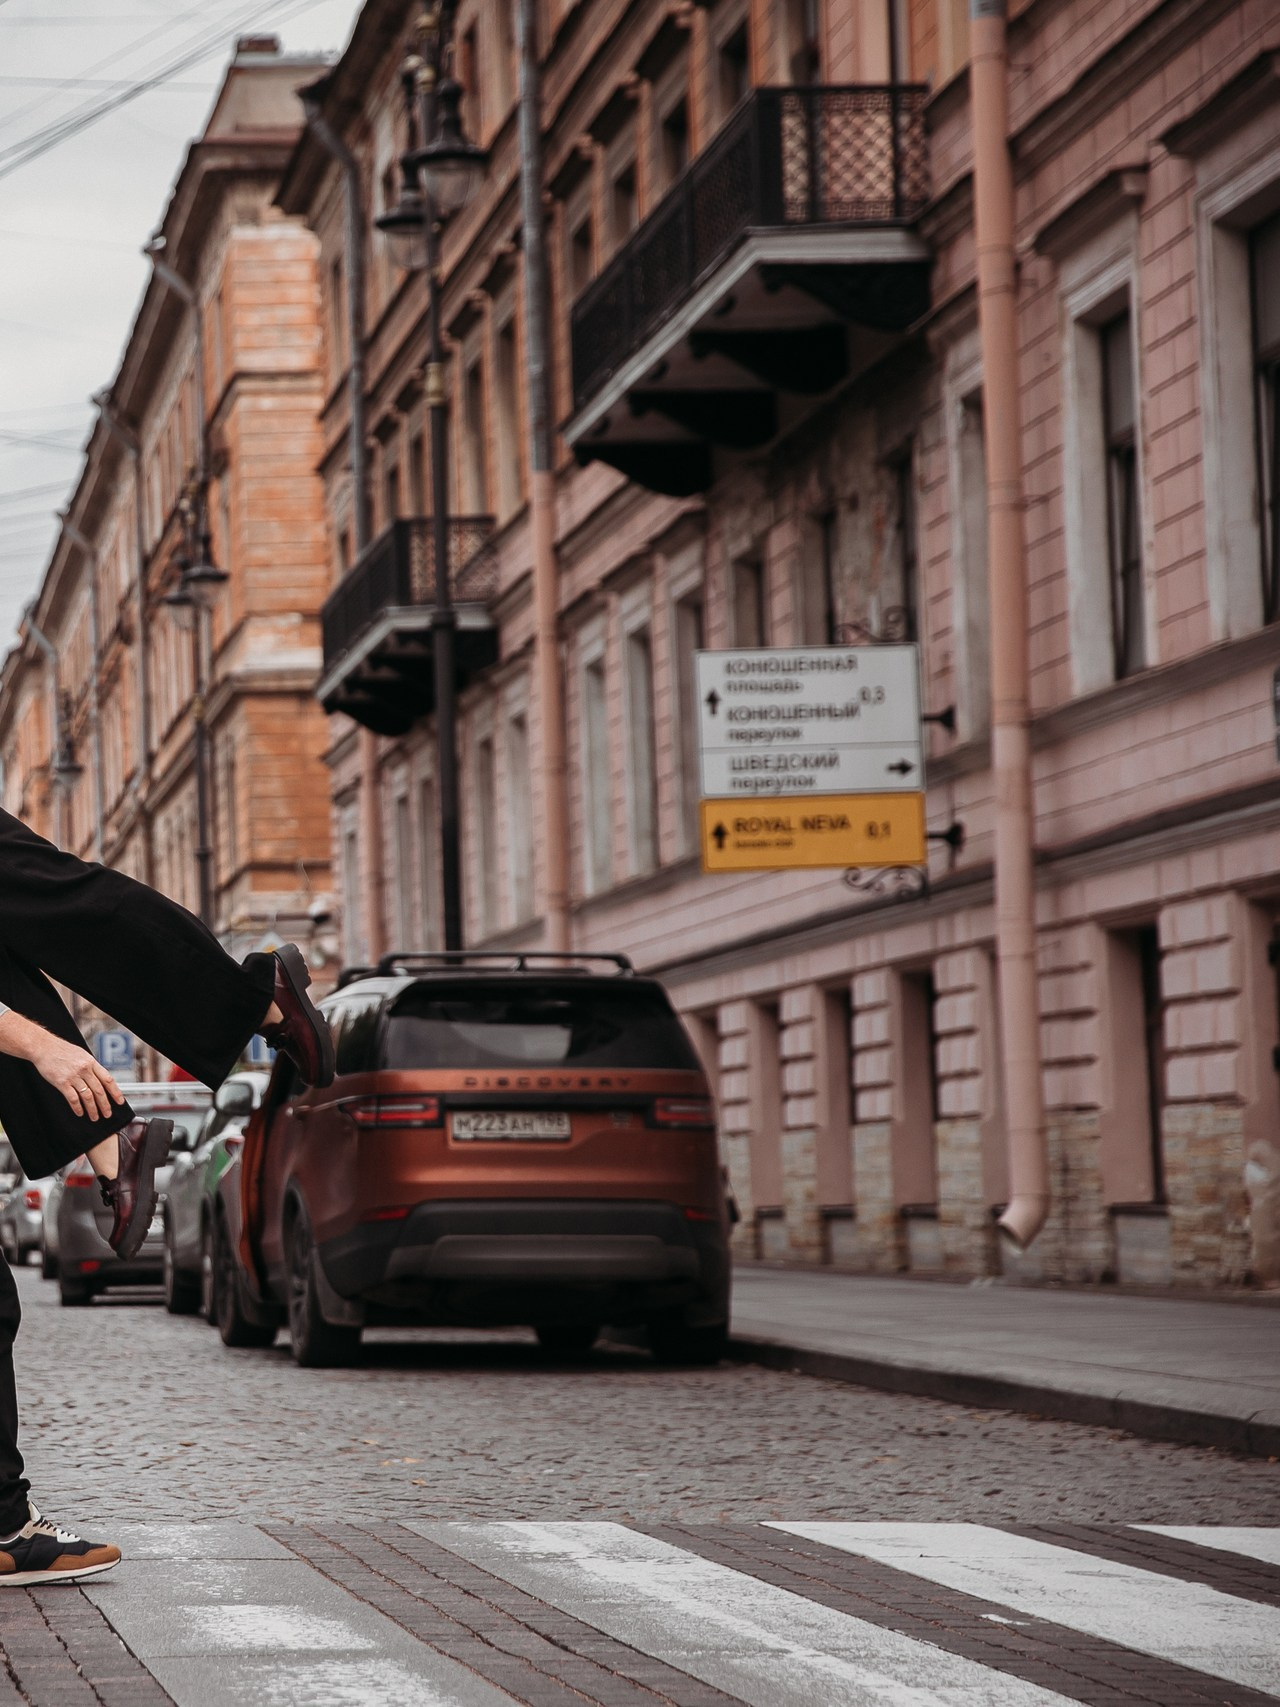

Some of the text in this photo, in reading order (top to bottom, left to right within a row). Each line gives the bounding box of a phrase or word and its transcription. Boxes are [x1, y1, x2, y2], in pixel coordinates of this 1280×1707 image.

[725, 655, 858, 675] КОНЮШЕННАЯ
[726, 701, 860, 722] КОНЮШЕННЫЙ
[731, 750, 840, 771] ШВЕДСКИЙ
[734, 814, 851, 833] ROYAL NEVA
[464, 1077, 630, 1087] DISCOVERY
